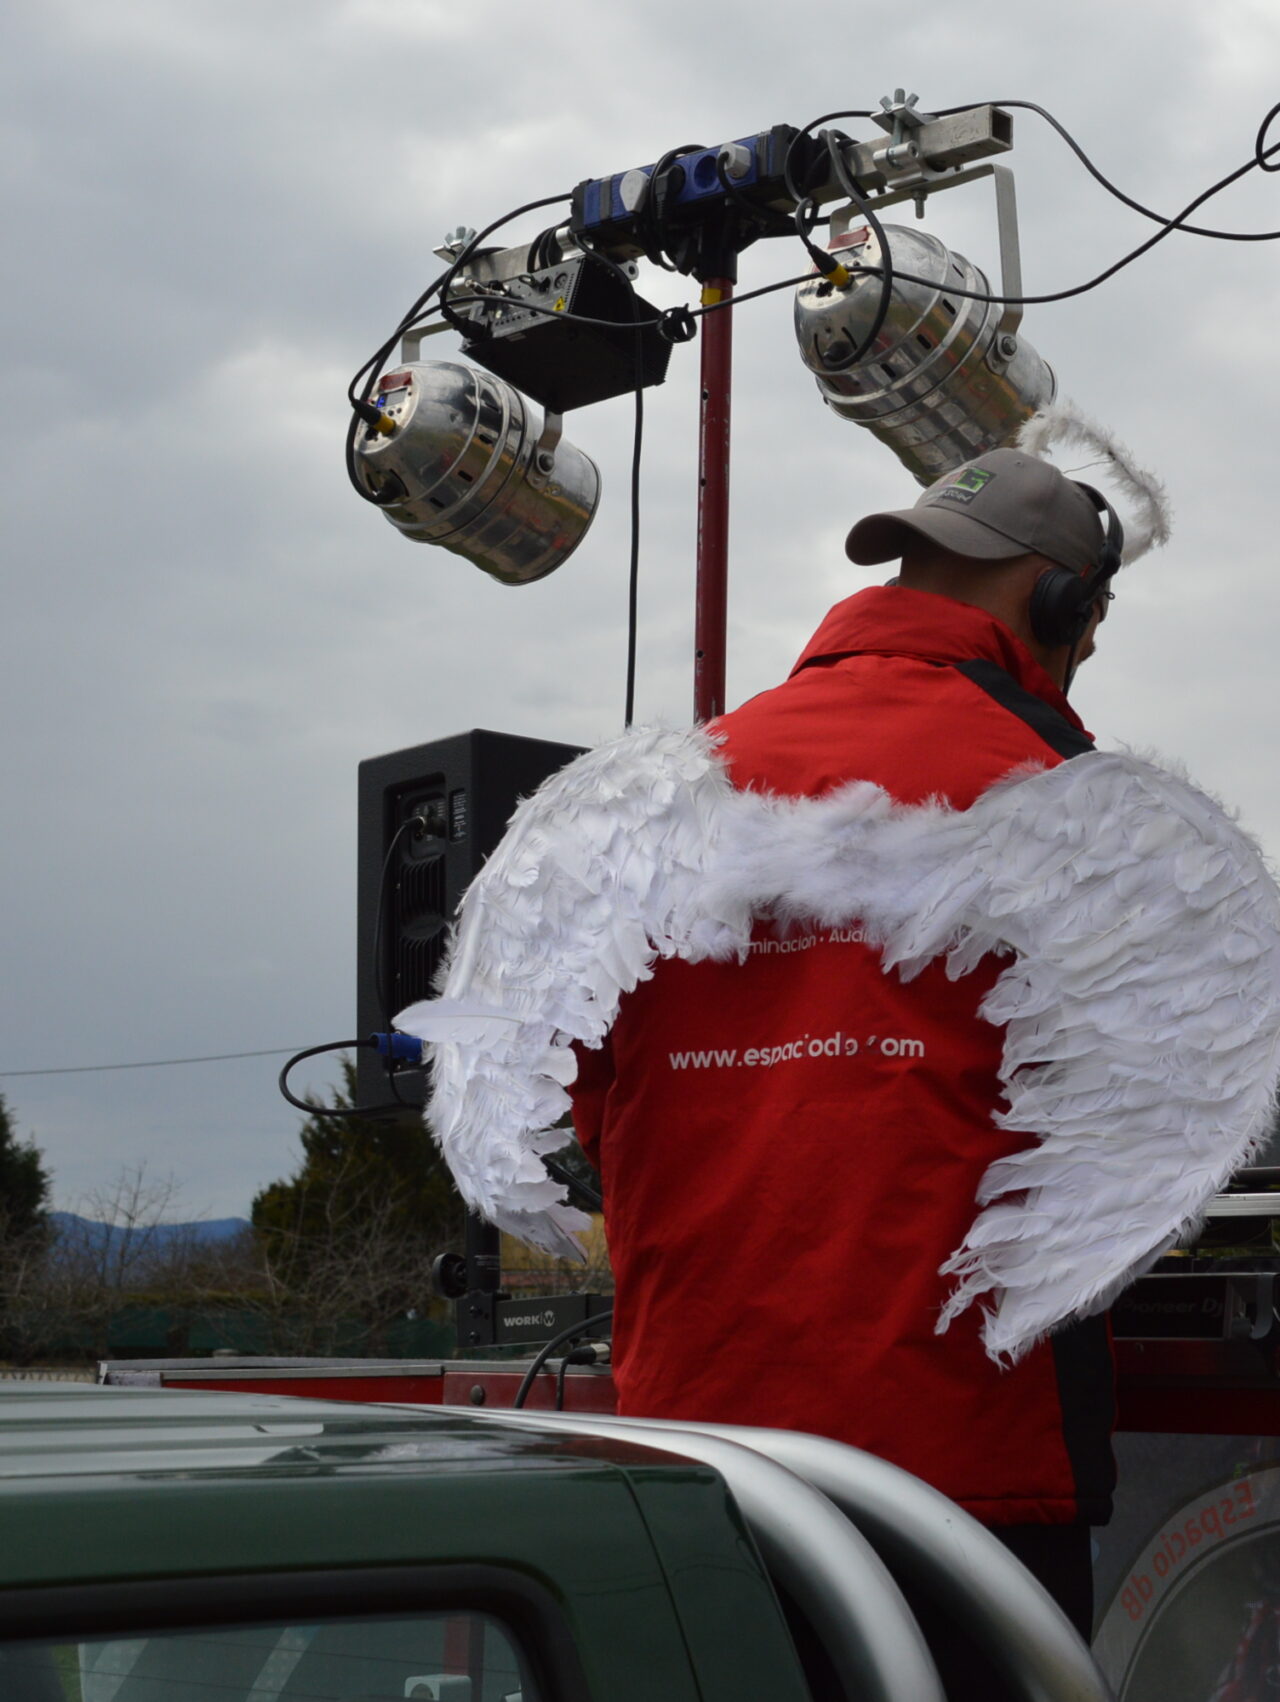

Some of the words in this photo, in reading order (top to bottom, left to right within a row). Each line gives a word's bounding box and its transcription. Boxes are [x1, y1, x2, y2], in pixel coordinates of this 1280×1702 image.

[752, 934, 816, 954] minacion
[1121, 1297, 1195, 1314] Pioneer
[503, 1314, 541, 1328] WORK
